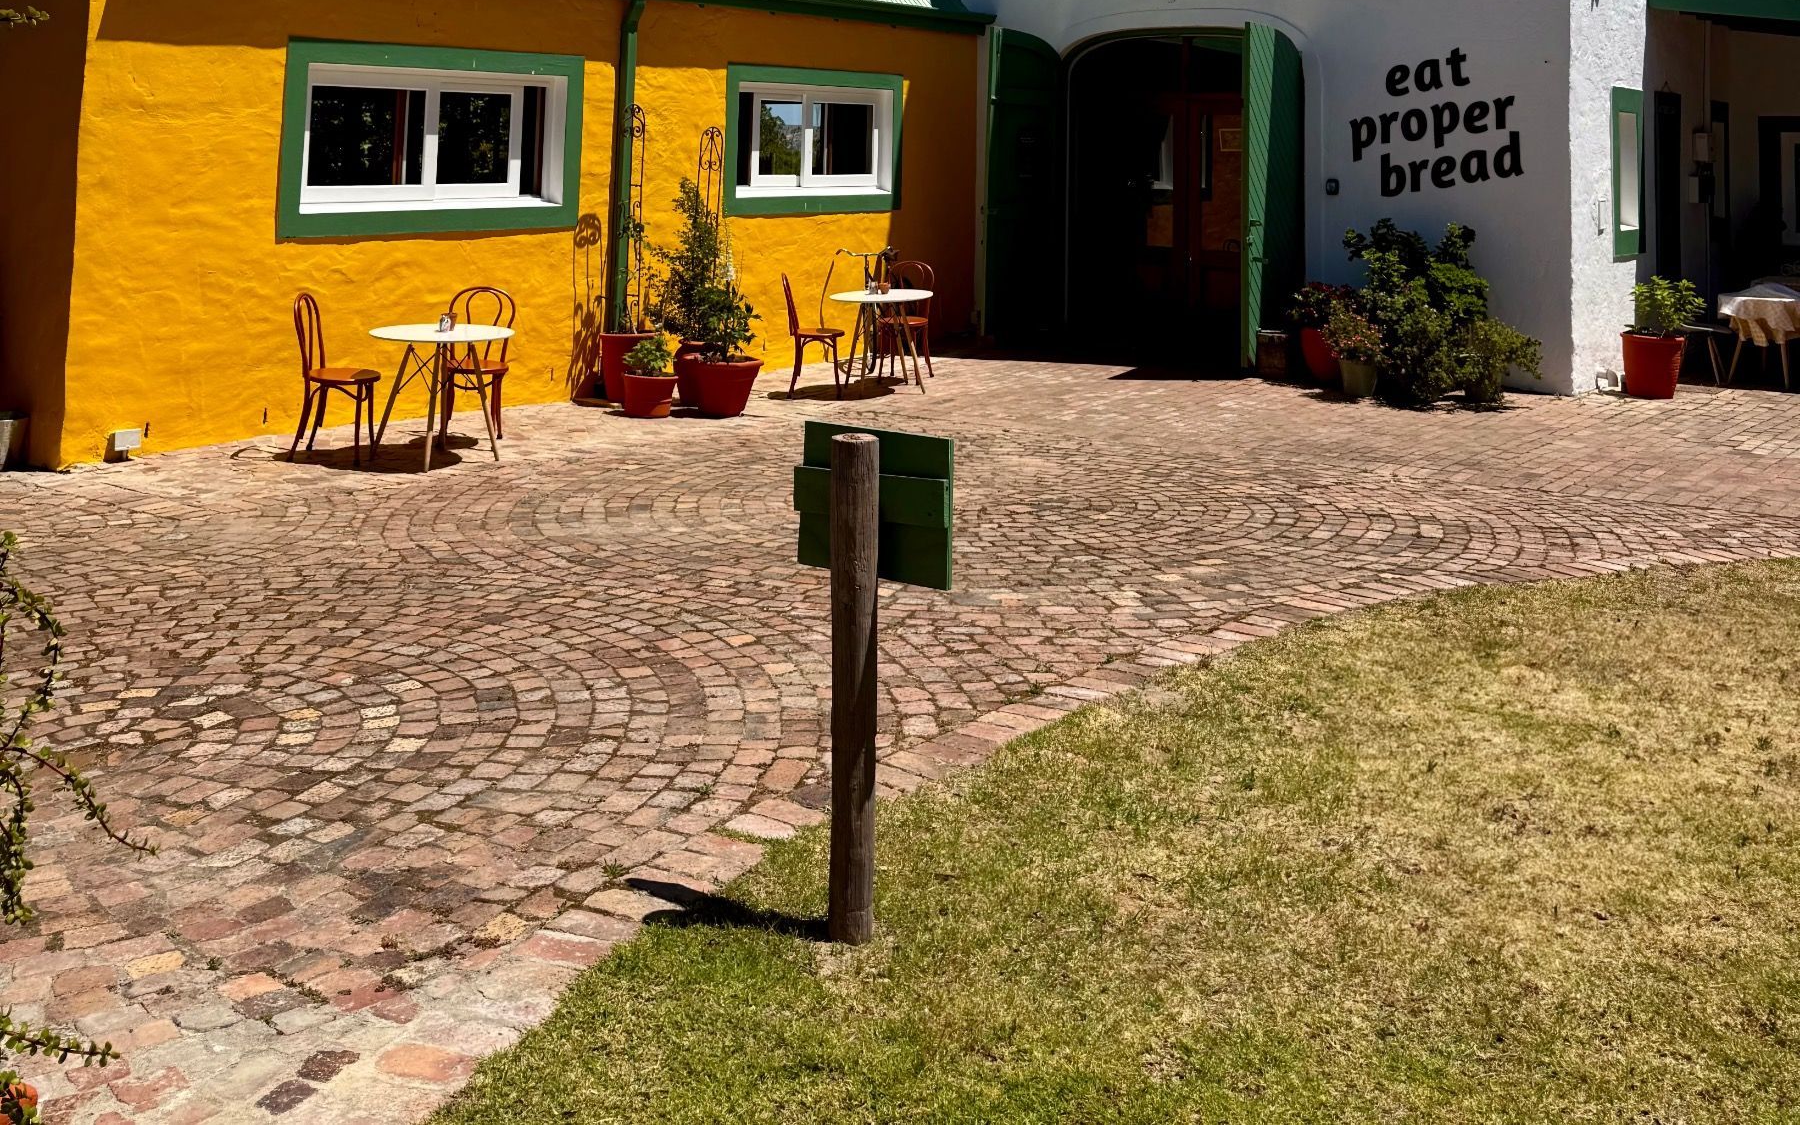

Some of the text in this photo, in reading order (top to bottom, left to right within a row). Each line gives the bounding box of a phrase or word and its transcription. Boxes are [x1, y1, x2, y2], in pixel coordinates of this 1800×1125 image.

[1385, 47, 1470, 97] eat
[1349, 95, 1516, 163] proper
[1380, 130, 1525, 197] bread
